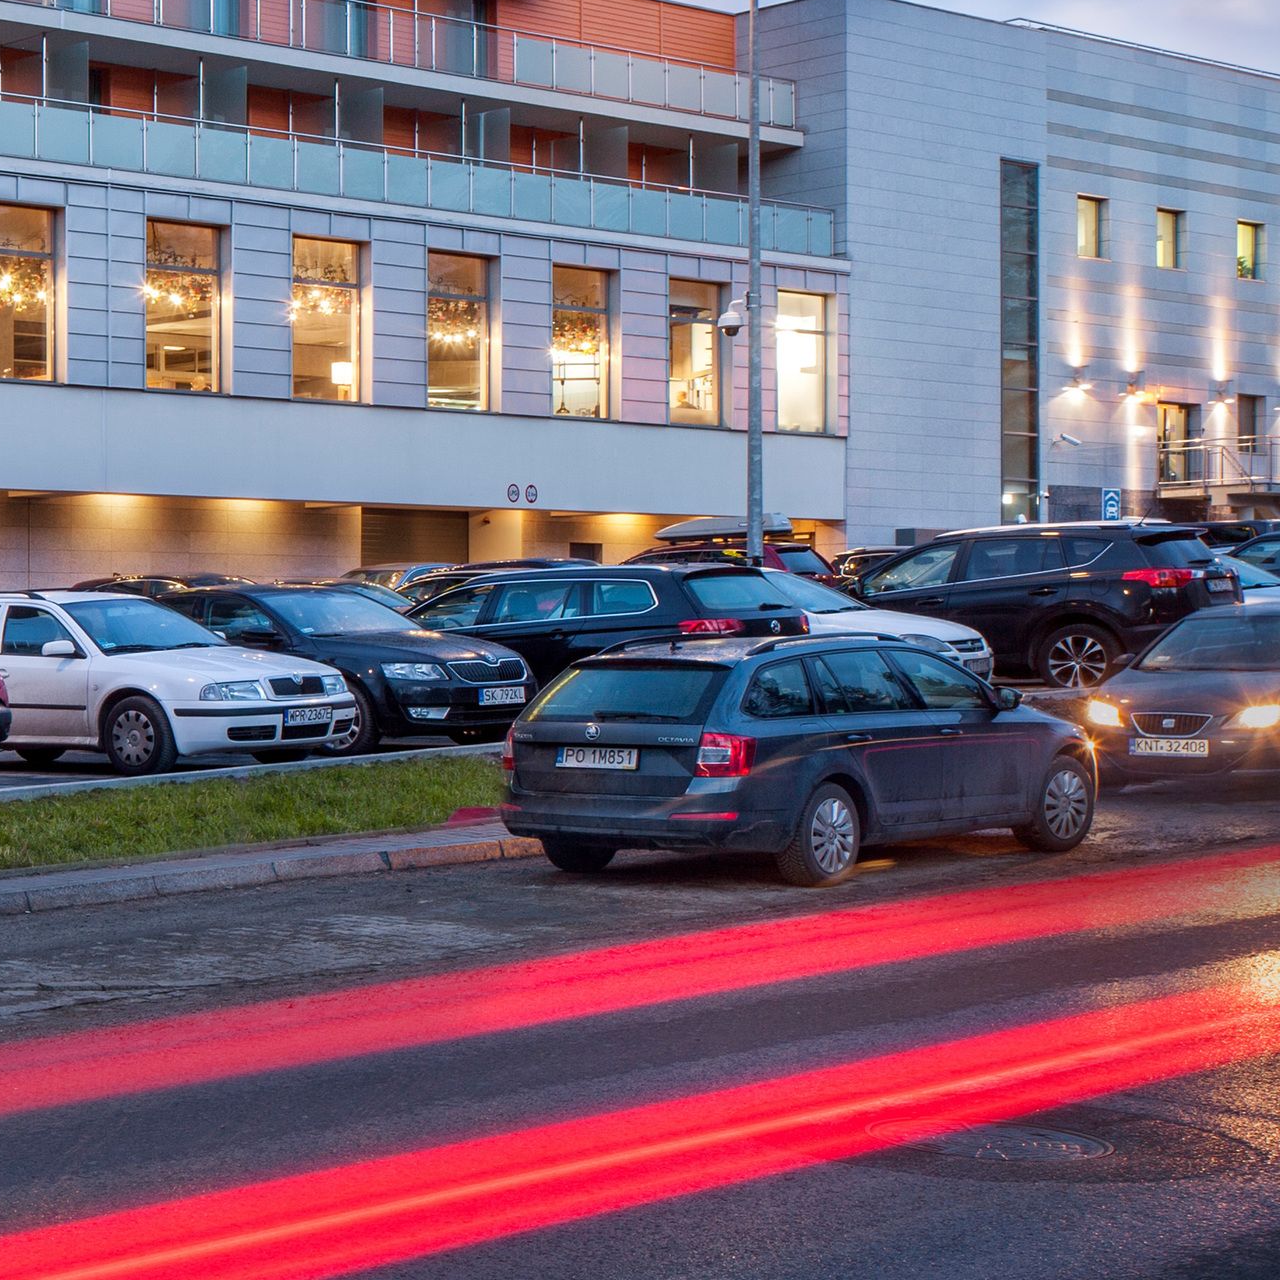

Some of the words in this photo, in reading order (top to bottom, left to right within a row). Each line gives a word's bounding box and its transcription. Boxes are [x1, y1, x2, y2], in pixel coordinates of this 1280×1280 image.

[484, 689, 497, 702] SK
[499, 688, 523, 700] 792KL
[1136, 739, 1160, 752] KNT
[1165, 740, 1207, 753] 32408
[565, 748, 586, 763] PO
[591, 749, 633, 765] 1M851
